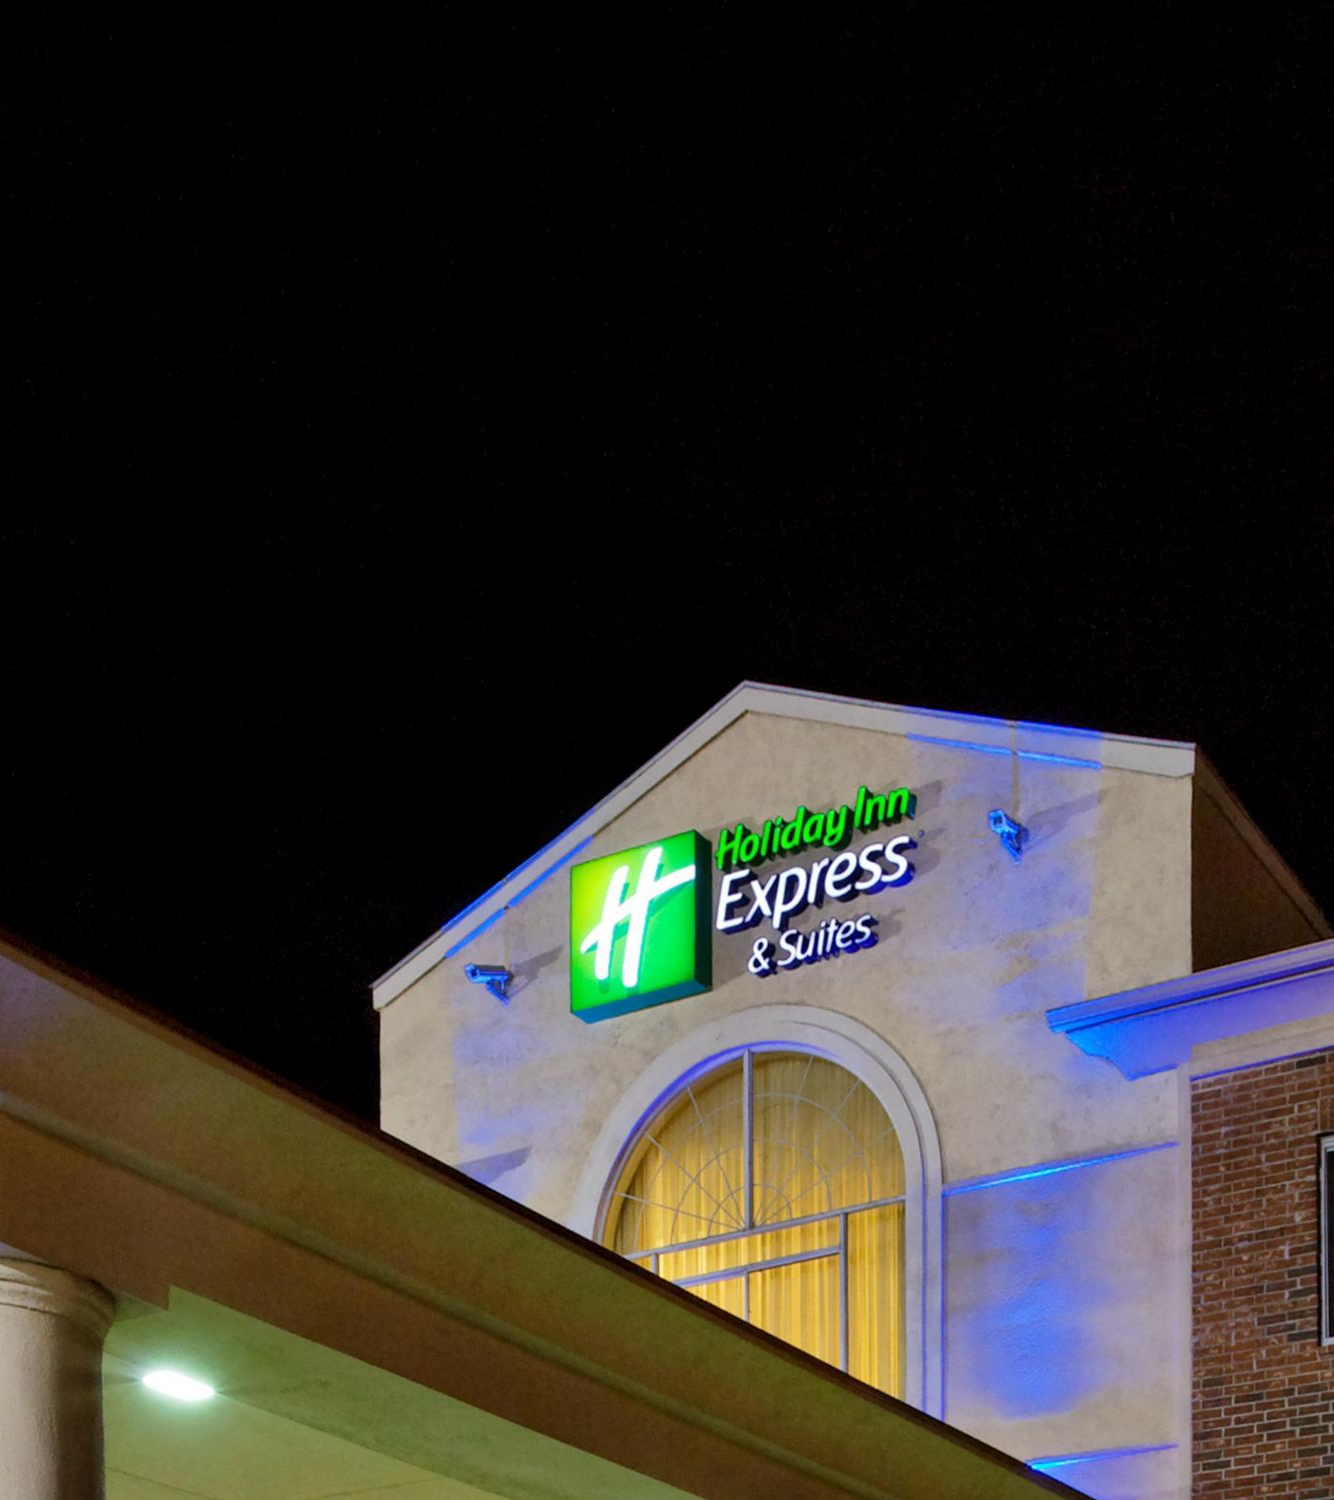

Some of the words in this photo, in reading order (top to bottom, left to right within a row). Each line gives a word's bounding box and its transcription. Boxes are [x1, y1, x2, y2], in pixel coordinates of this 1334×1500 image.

[715, 804, 849, 871] Holiday
[854, 785, 910, 829] Inn
[716, 834, 912, 930] Express
[747, 937, 770, 975] &
[777, 914, 873, 968] Suites
